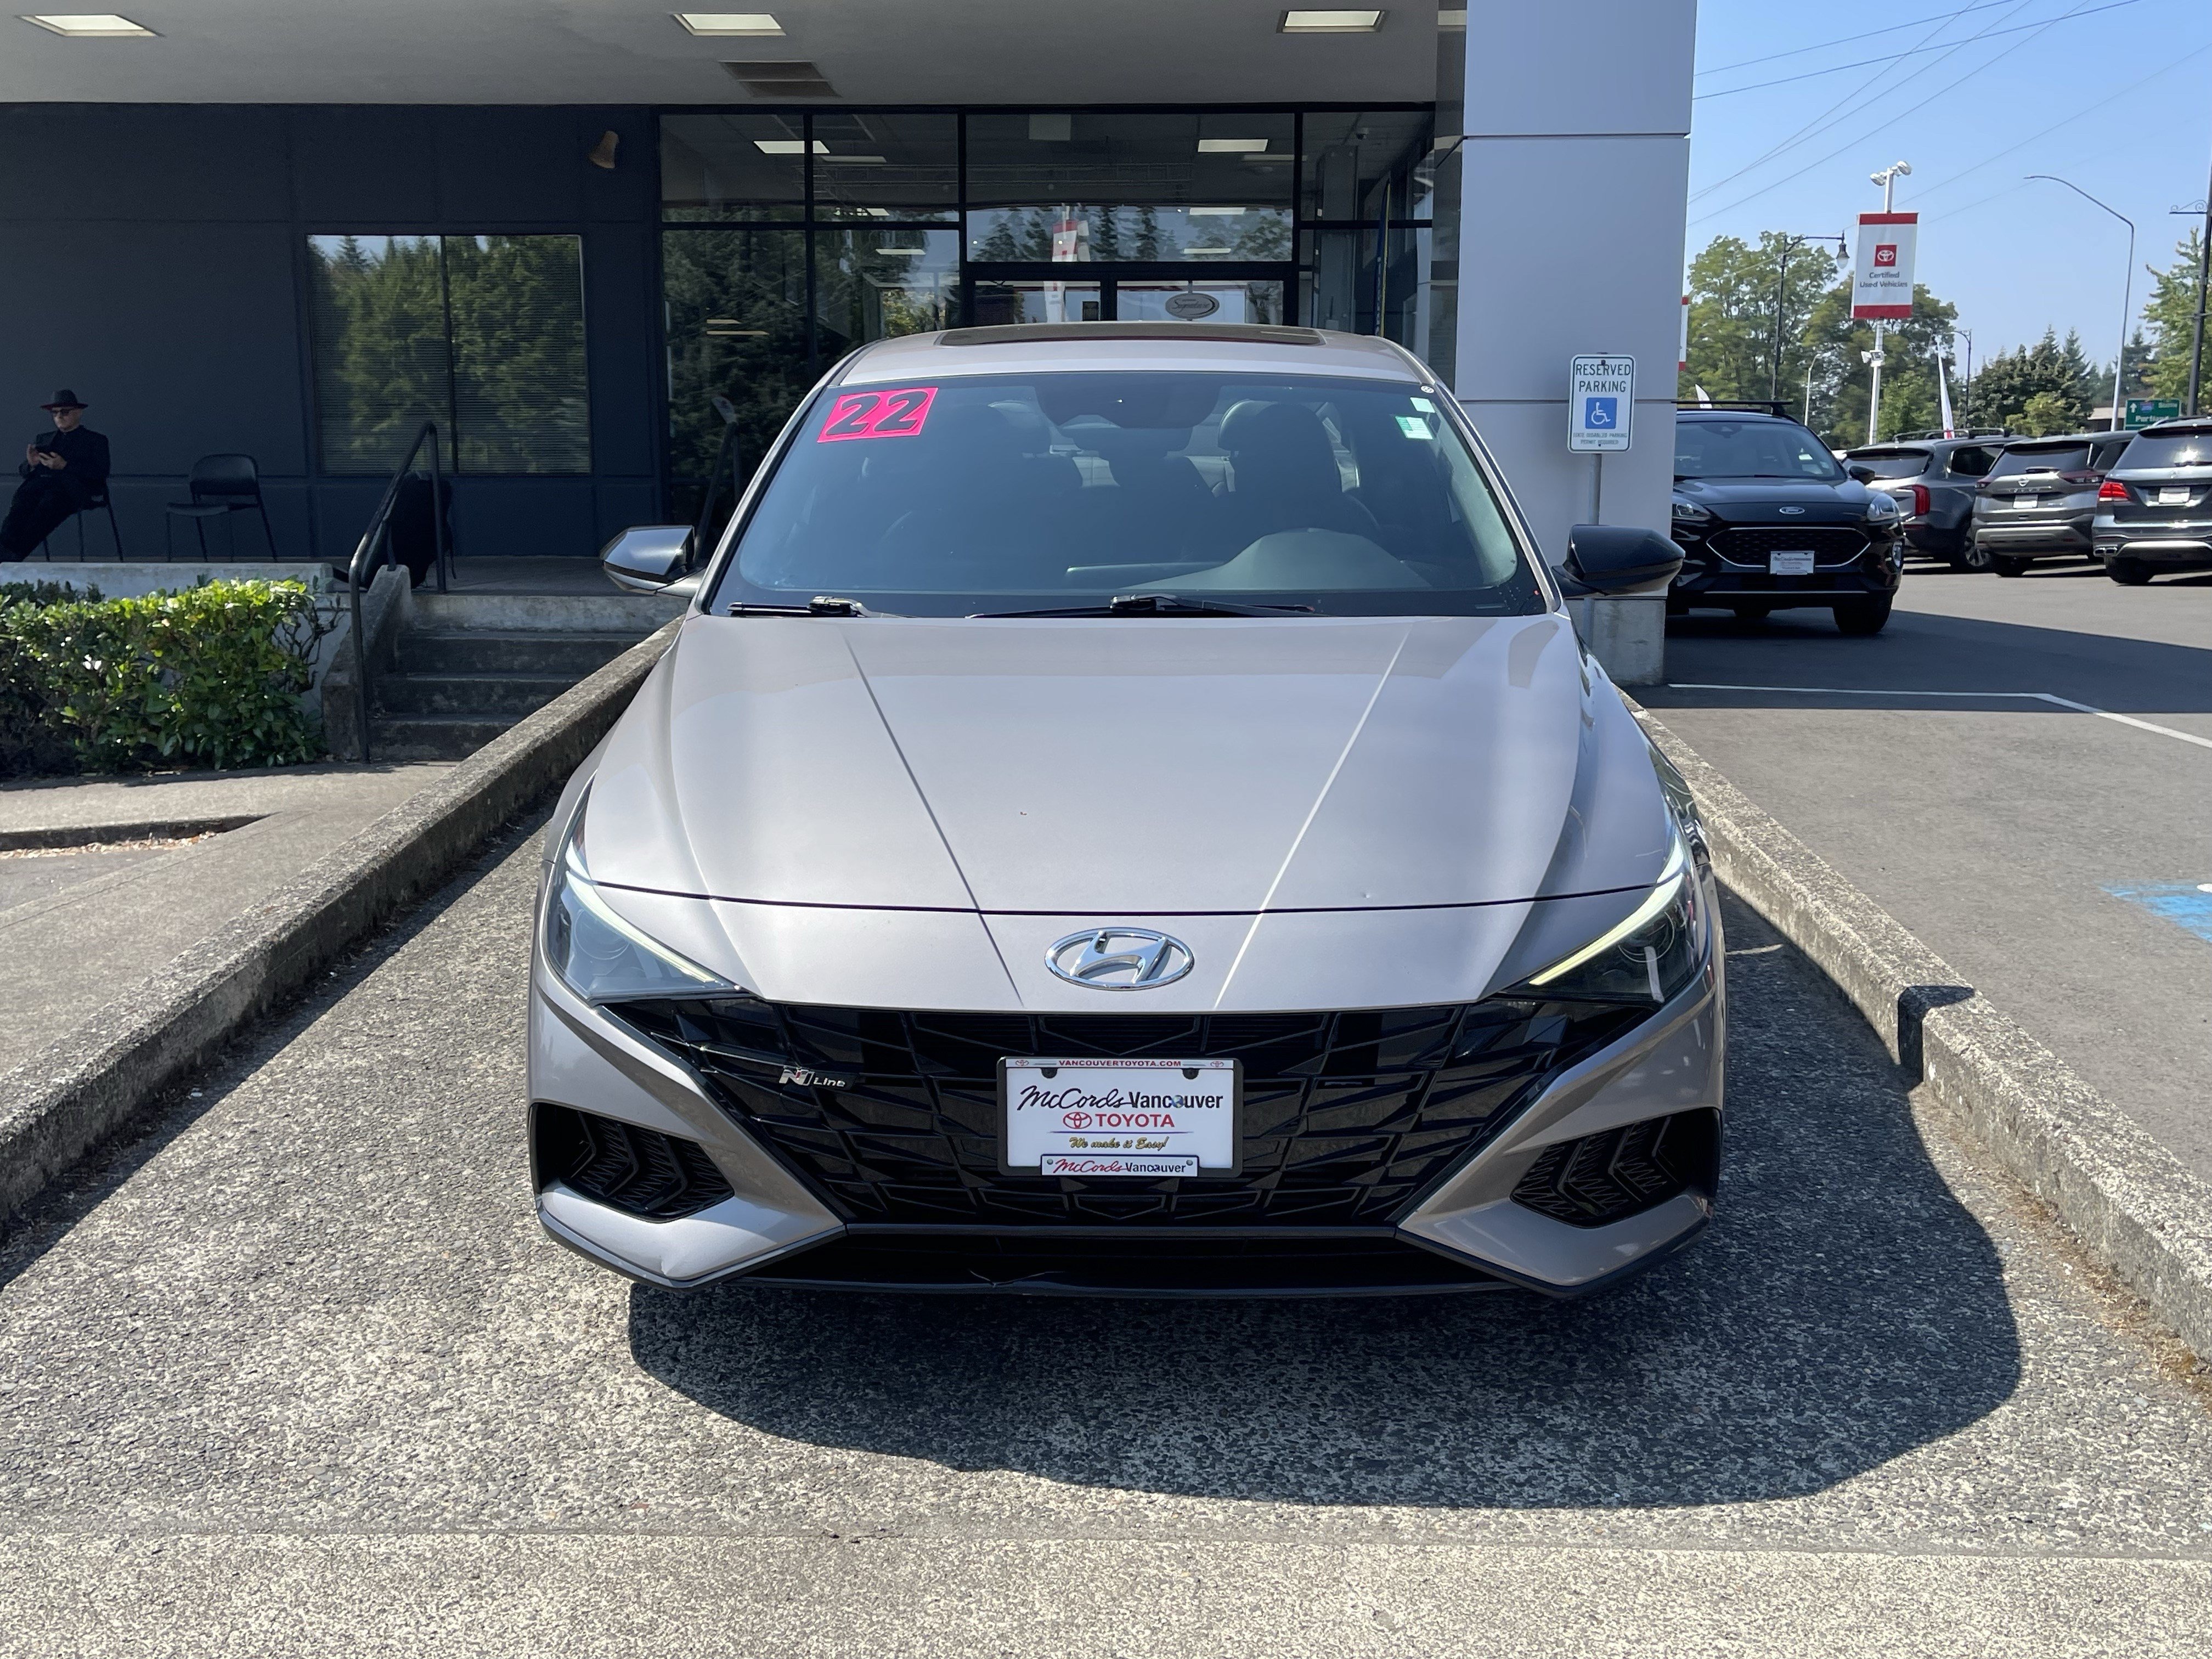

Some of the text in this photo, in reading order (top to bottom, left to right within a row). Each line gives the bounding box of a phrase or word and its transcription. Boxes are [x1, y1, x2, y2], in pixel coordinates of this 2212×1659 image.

[1576, 364, 1630, 375] RESERVED
[1579, 381, 1626, 392] PARKING
[825, 390, 928, 435] 22
[813, 1077, 845, 1087] Line
[1017, 1085, 1223, 1110] McCords Vancouver
[1095, 1114, 1175, 1127] TOYOTA
[1069, 1136, 1170, 1151] We make it Easy!
[1053, 1159, 1187, 1173] McCords Vancouver
